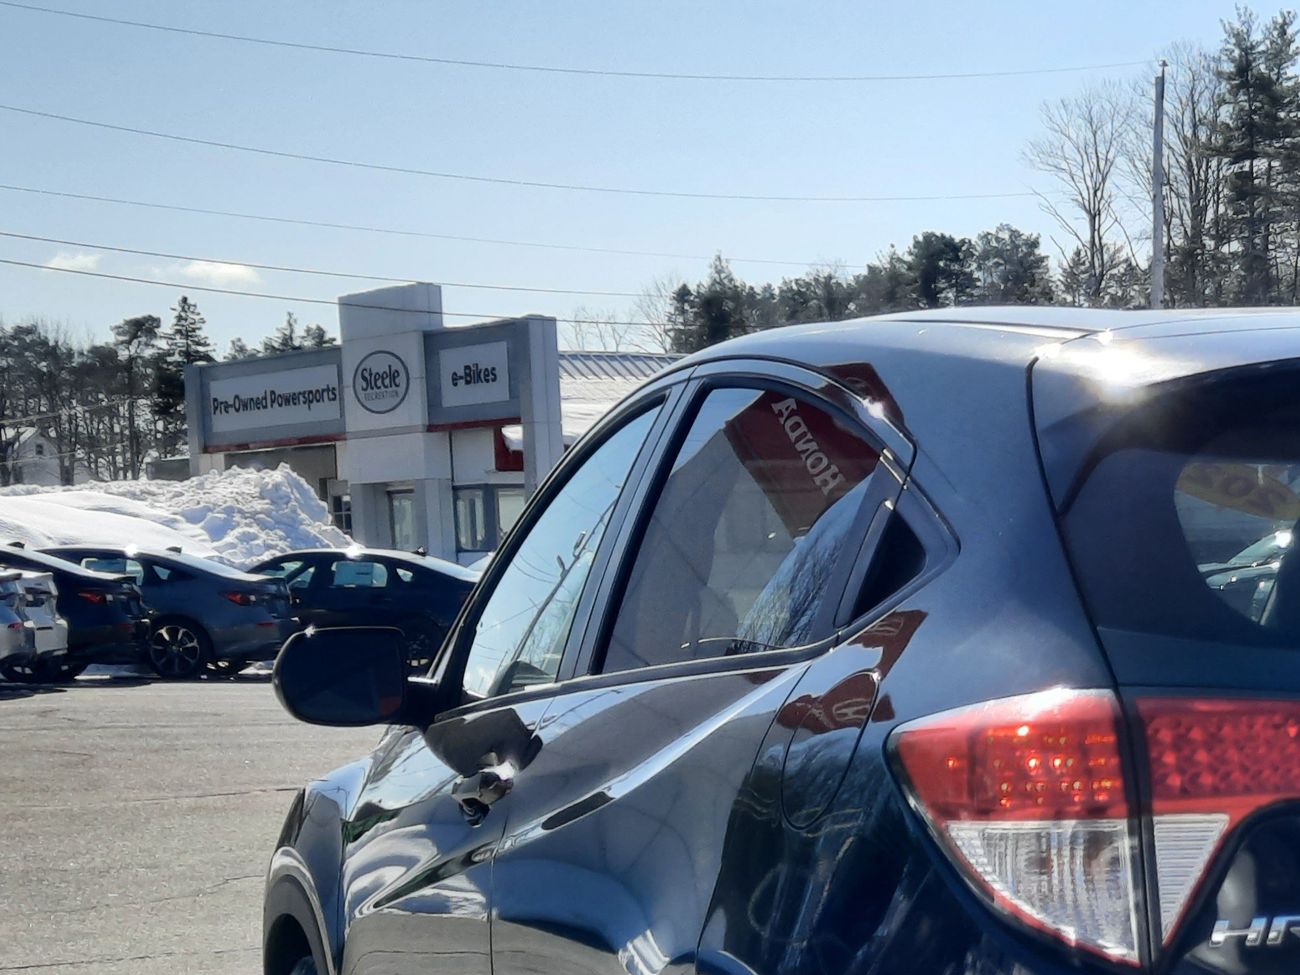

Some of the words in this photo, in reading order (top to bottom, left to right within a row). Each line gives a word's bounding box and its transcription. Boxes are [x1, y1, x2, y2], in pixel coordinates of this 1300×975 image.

[361, 364, 400, 392] Steele
[451, 363, 497, 387] e-Bikes
[212, 389, 268, 415] Pre-Owned
[269, 384, 337, 411] Powersports
